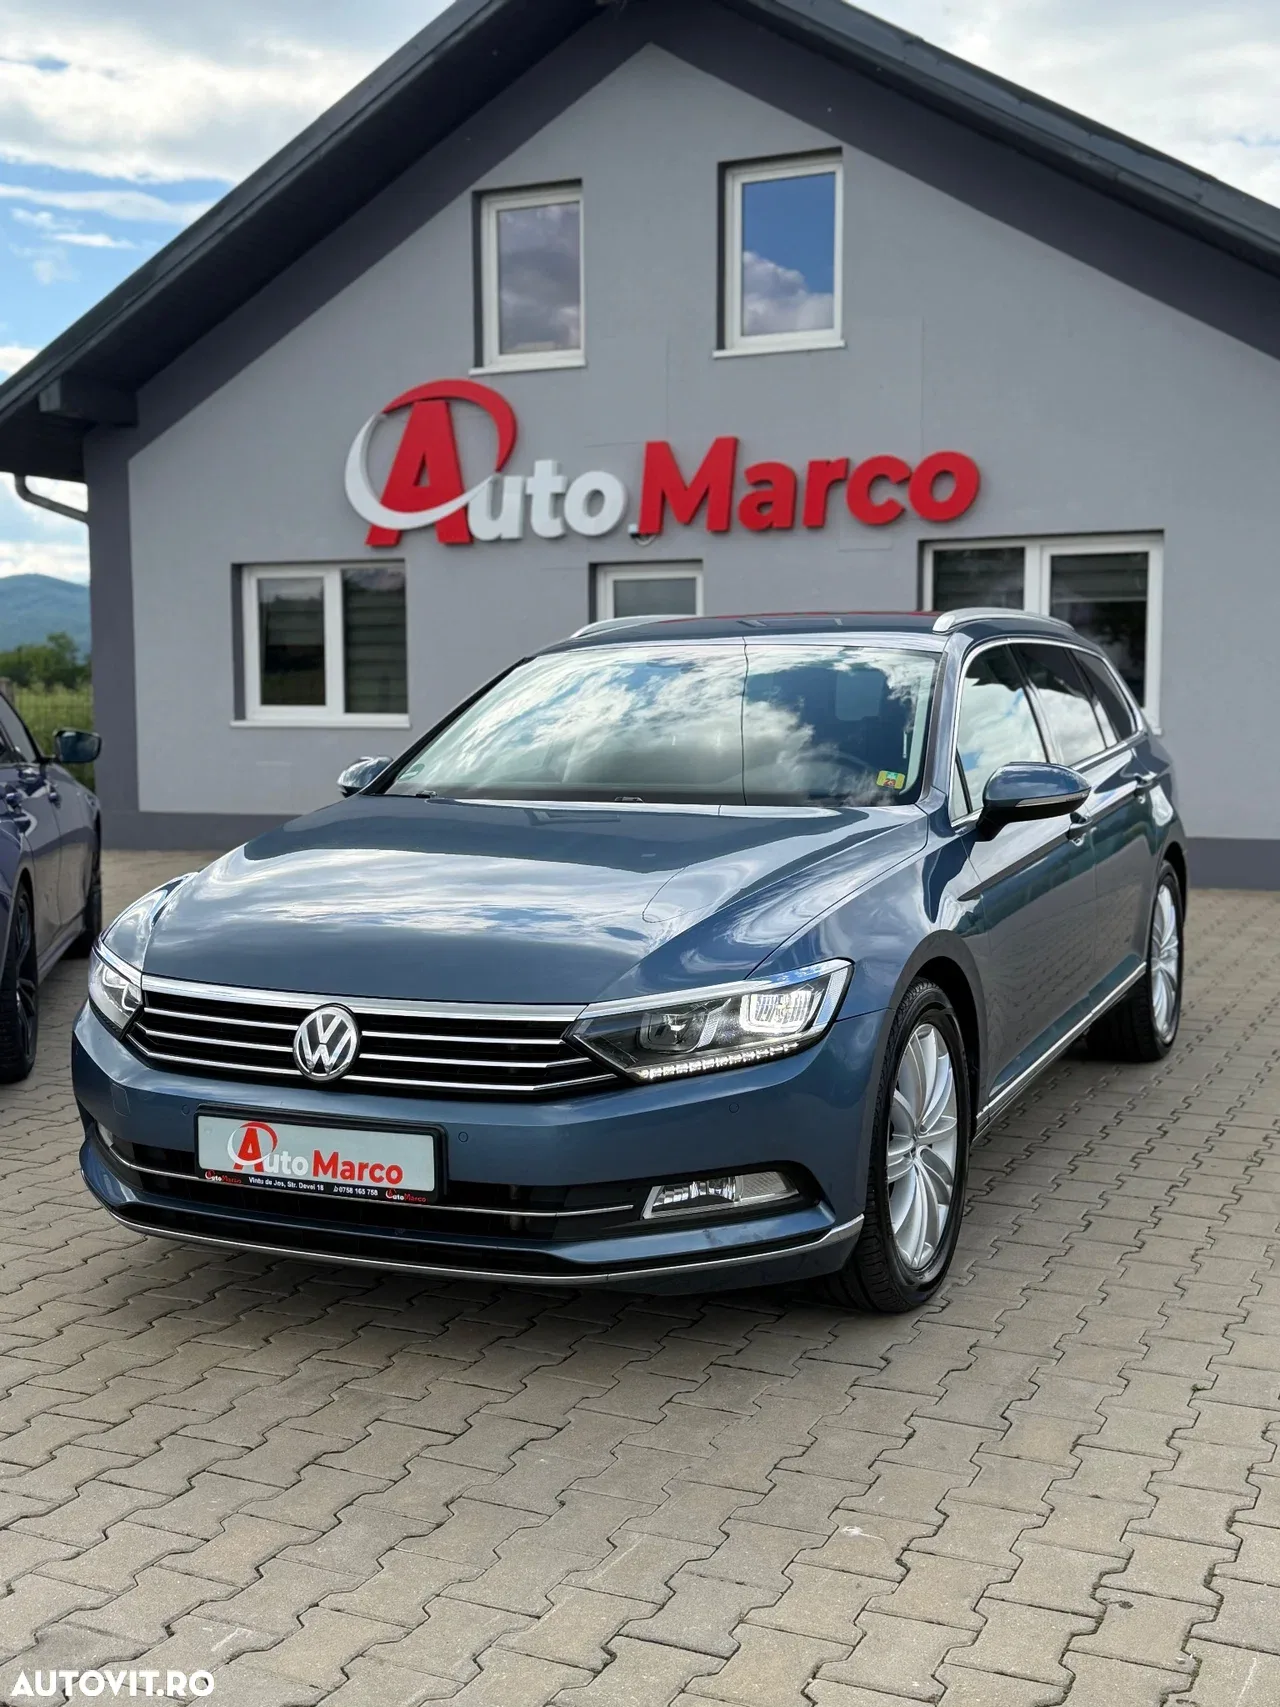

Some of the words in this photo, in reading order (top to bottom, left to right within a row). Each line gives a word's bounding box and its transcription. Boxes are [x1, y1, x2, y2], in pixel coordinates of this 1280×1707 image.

[357, 392, 626, 546] Auto
[638, 436, 980, 536] Marco
[231, 1124, 309, 1176] Auto
[312, 1149, 404, 1185] Marco
